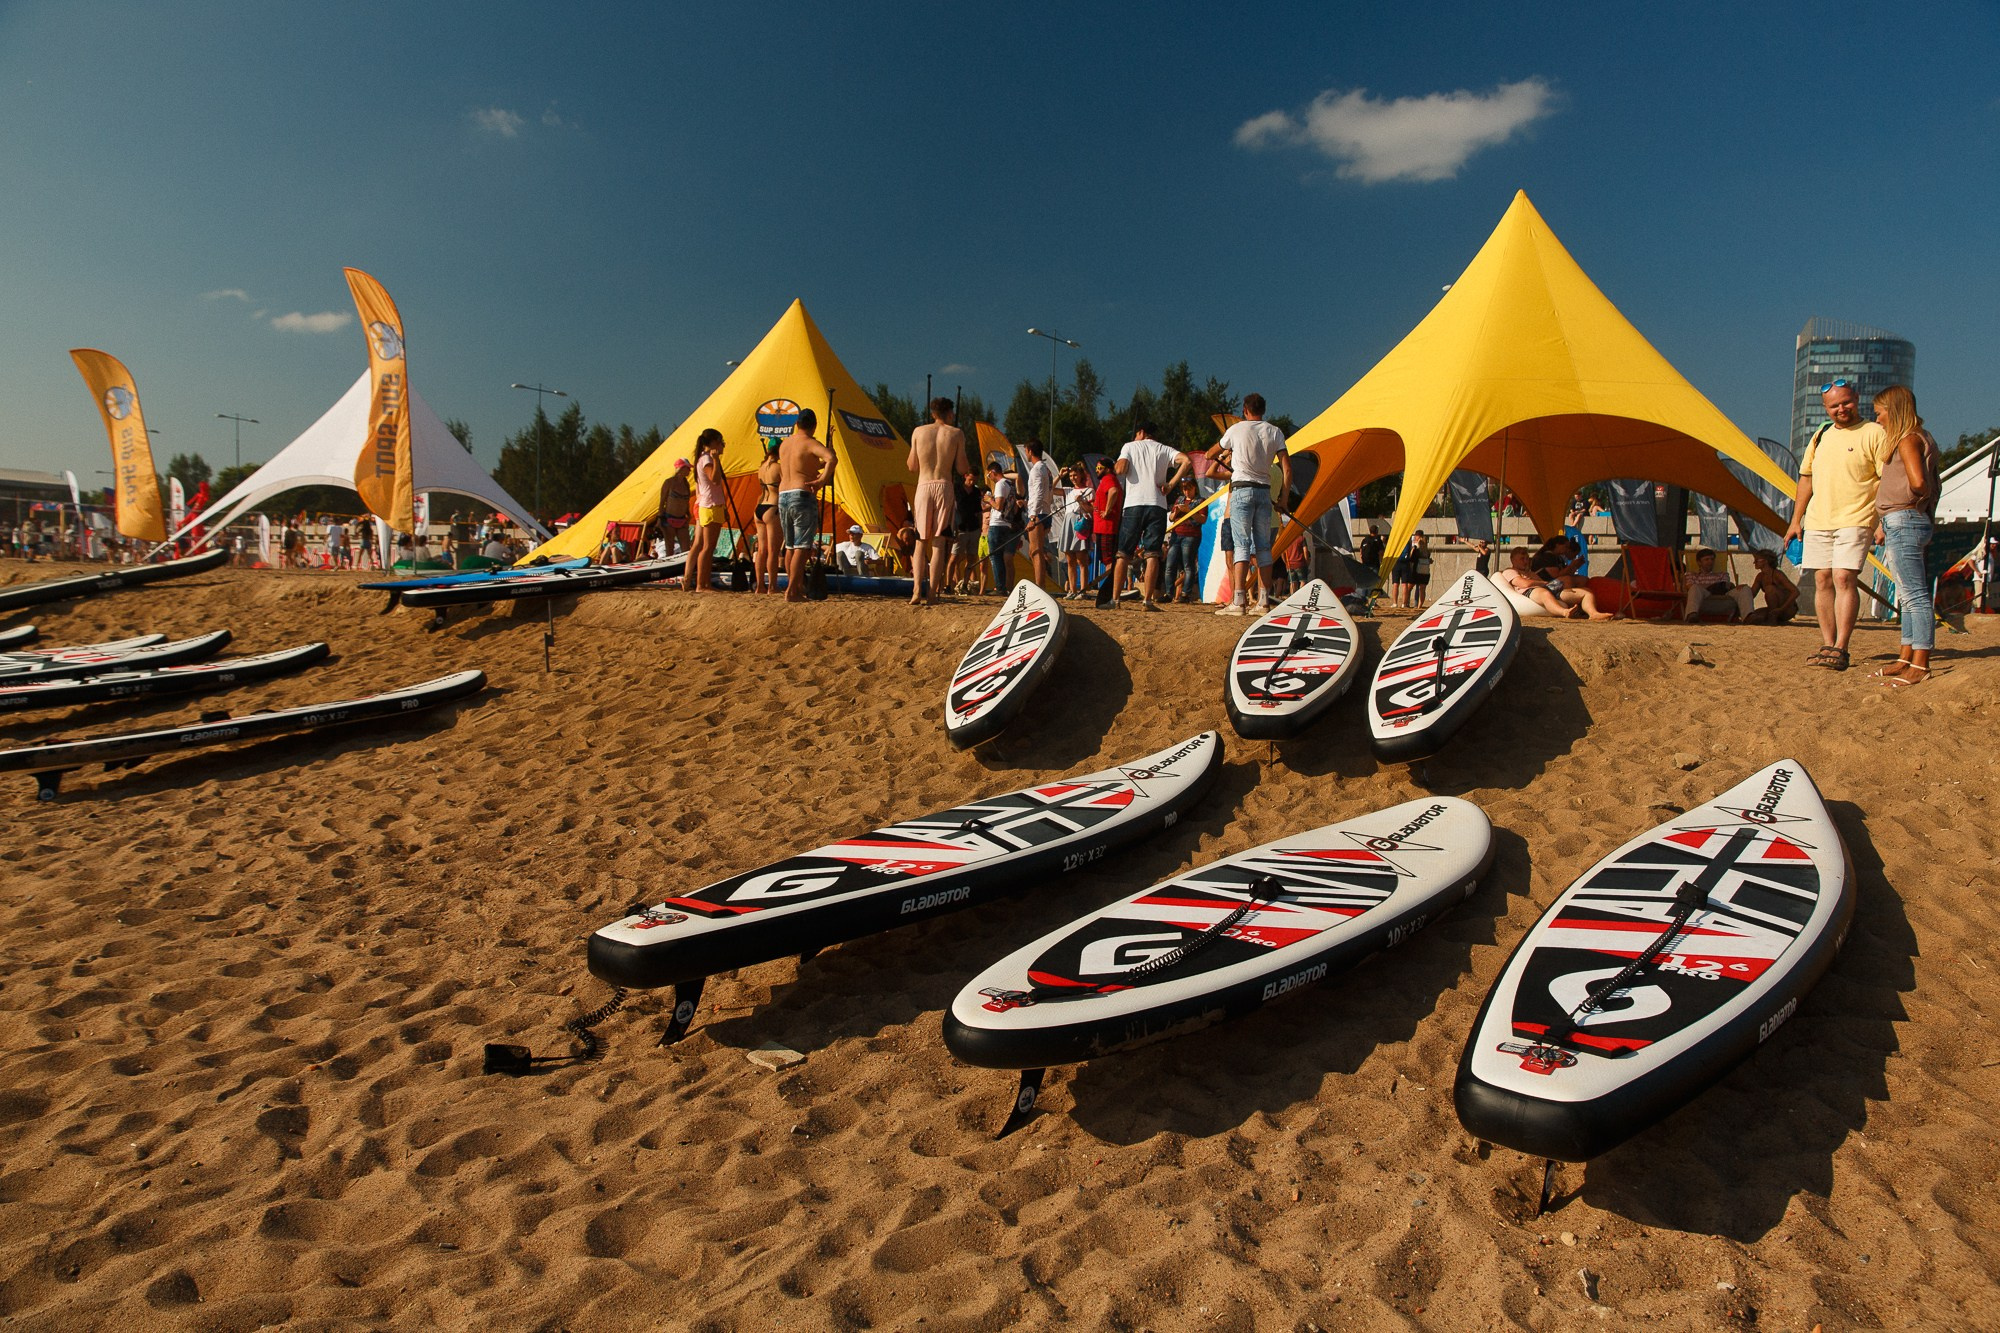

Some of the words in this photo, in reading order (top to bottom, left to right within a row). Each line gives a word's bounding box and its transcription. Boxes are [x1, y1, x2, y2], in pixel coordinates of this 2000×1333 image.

[759, 426, 773, 434] SUP
[863, 421, 888, 435] SPOT
[1307, 584, 1322, 607] GLADIATOR
[1461, 575, 1475, 601] GLADIATOR
[401, 699, 419, 709] PRO
[180, 727, 240, 743] GLADIATOR
[1148, 739, 1205, 773] GLADIATOR
[1755, 768, 1794, 814] GLADIATOR
[1164, 811, 1178, 829] PRO
[1387, 804, 1448, 842] GLADIATOR
[1088, 847, 1095, 862] X
[726, 866, 848, 902] G
[900, 886, 971, 915] GLADIATOR
[1236, 935, 1278, 947] PRO
[1079, 932, 1182, 975] G
[1658, 964, 1721, 980] PRO
[1729, 963, 1750, 972] 6
[1261, 962, 1328, 1001] GLADIATOR
[1758, 997, 1797, 1044] GLADIATOR
